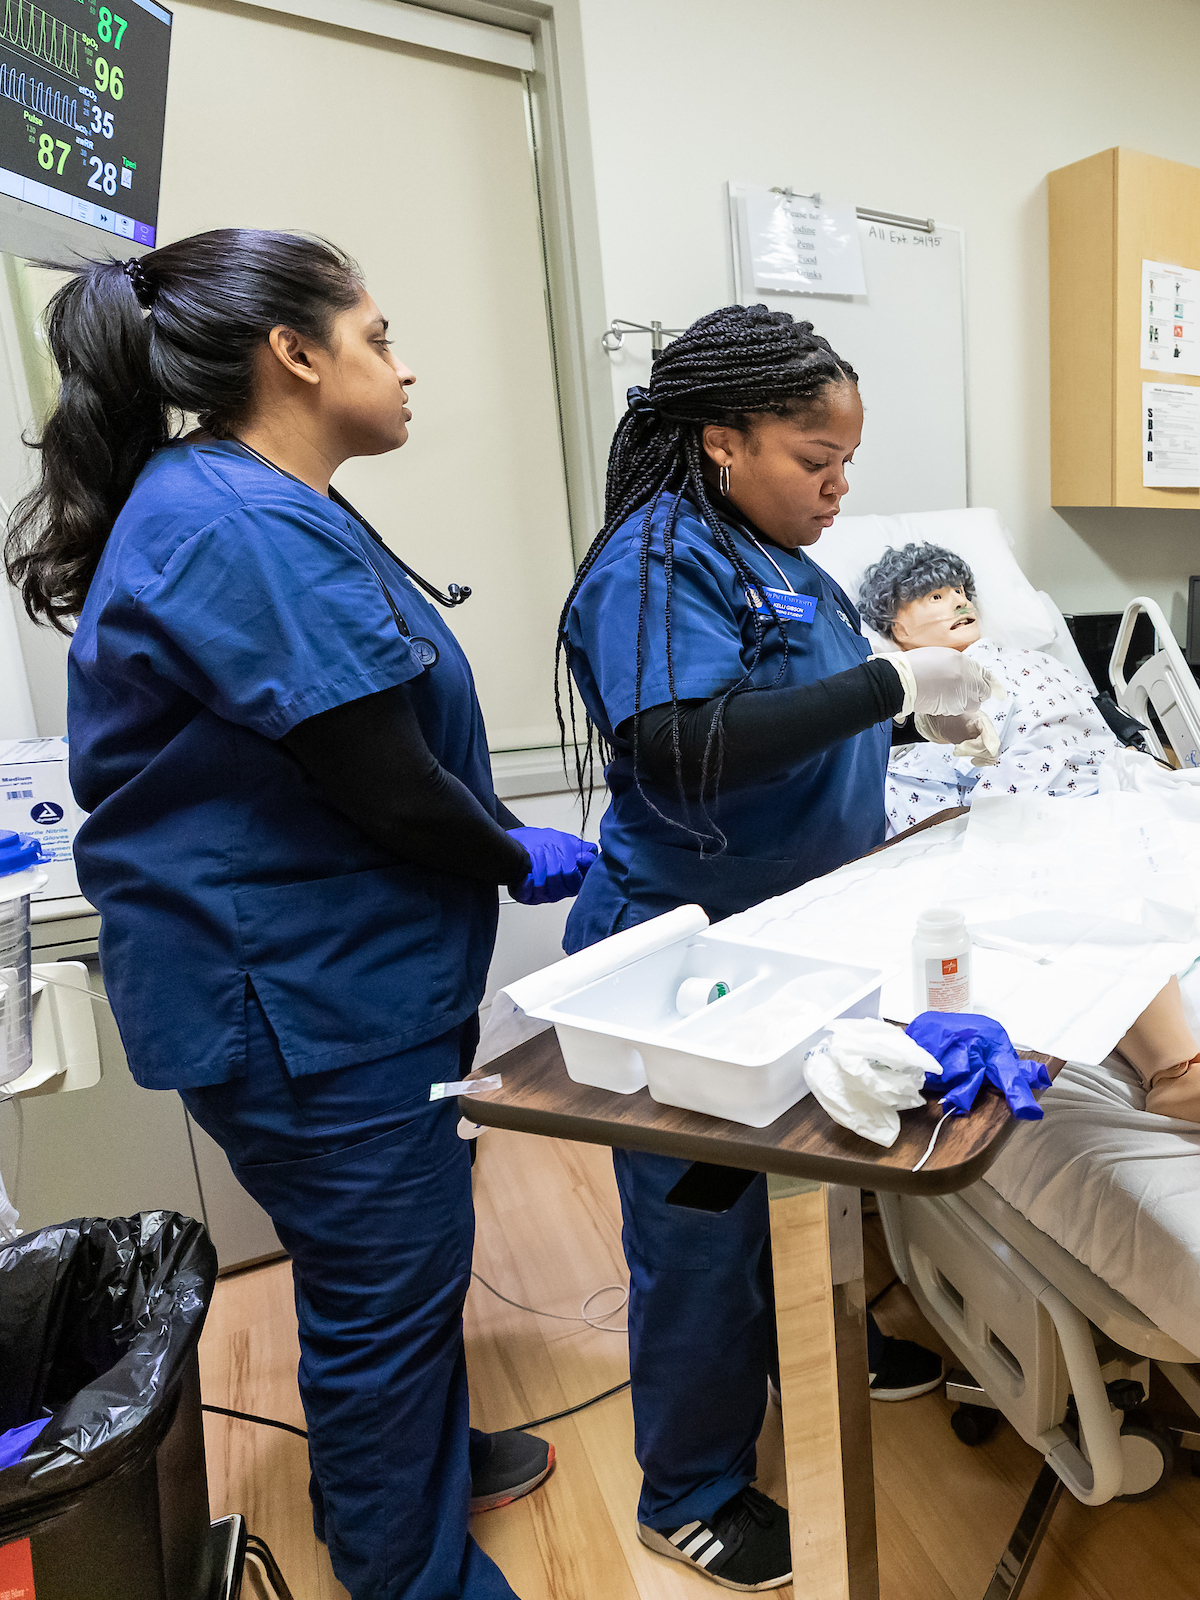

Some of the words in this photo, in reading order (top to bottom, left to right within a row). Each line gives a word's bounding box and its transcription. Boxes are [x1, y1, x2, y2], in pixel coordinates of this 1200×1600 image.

[97, 6, 128, 50] 87
[94, 56, 124, 101] 96
[23, 110, 43, 127] Pulse
[90, 105, 115, 139] 35
[37, 133, 72, 176] 87
[87, 155, 118, 197] 28
[783, 207, 807, 219] Pease
[868, 225, 885, 241] All
[798, 254, 817, 265] Food
[1147, 407, 1153, 418] S
